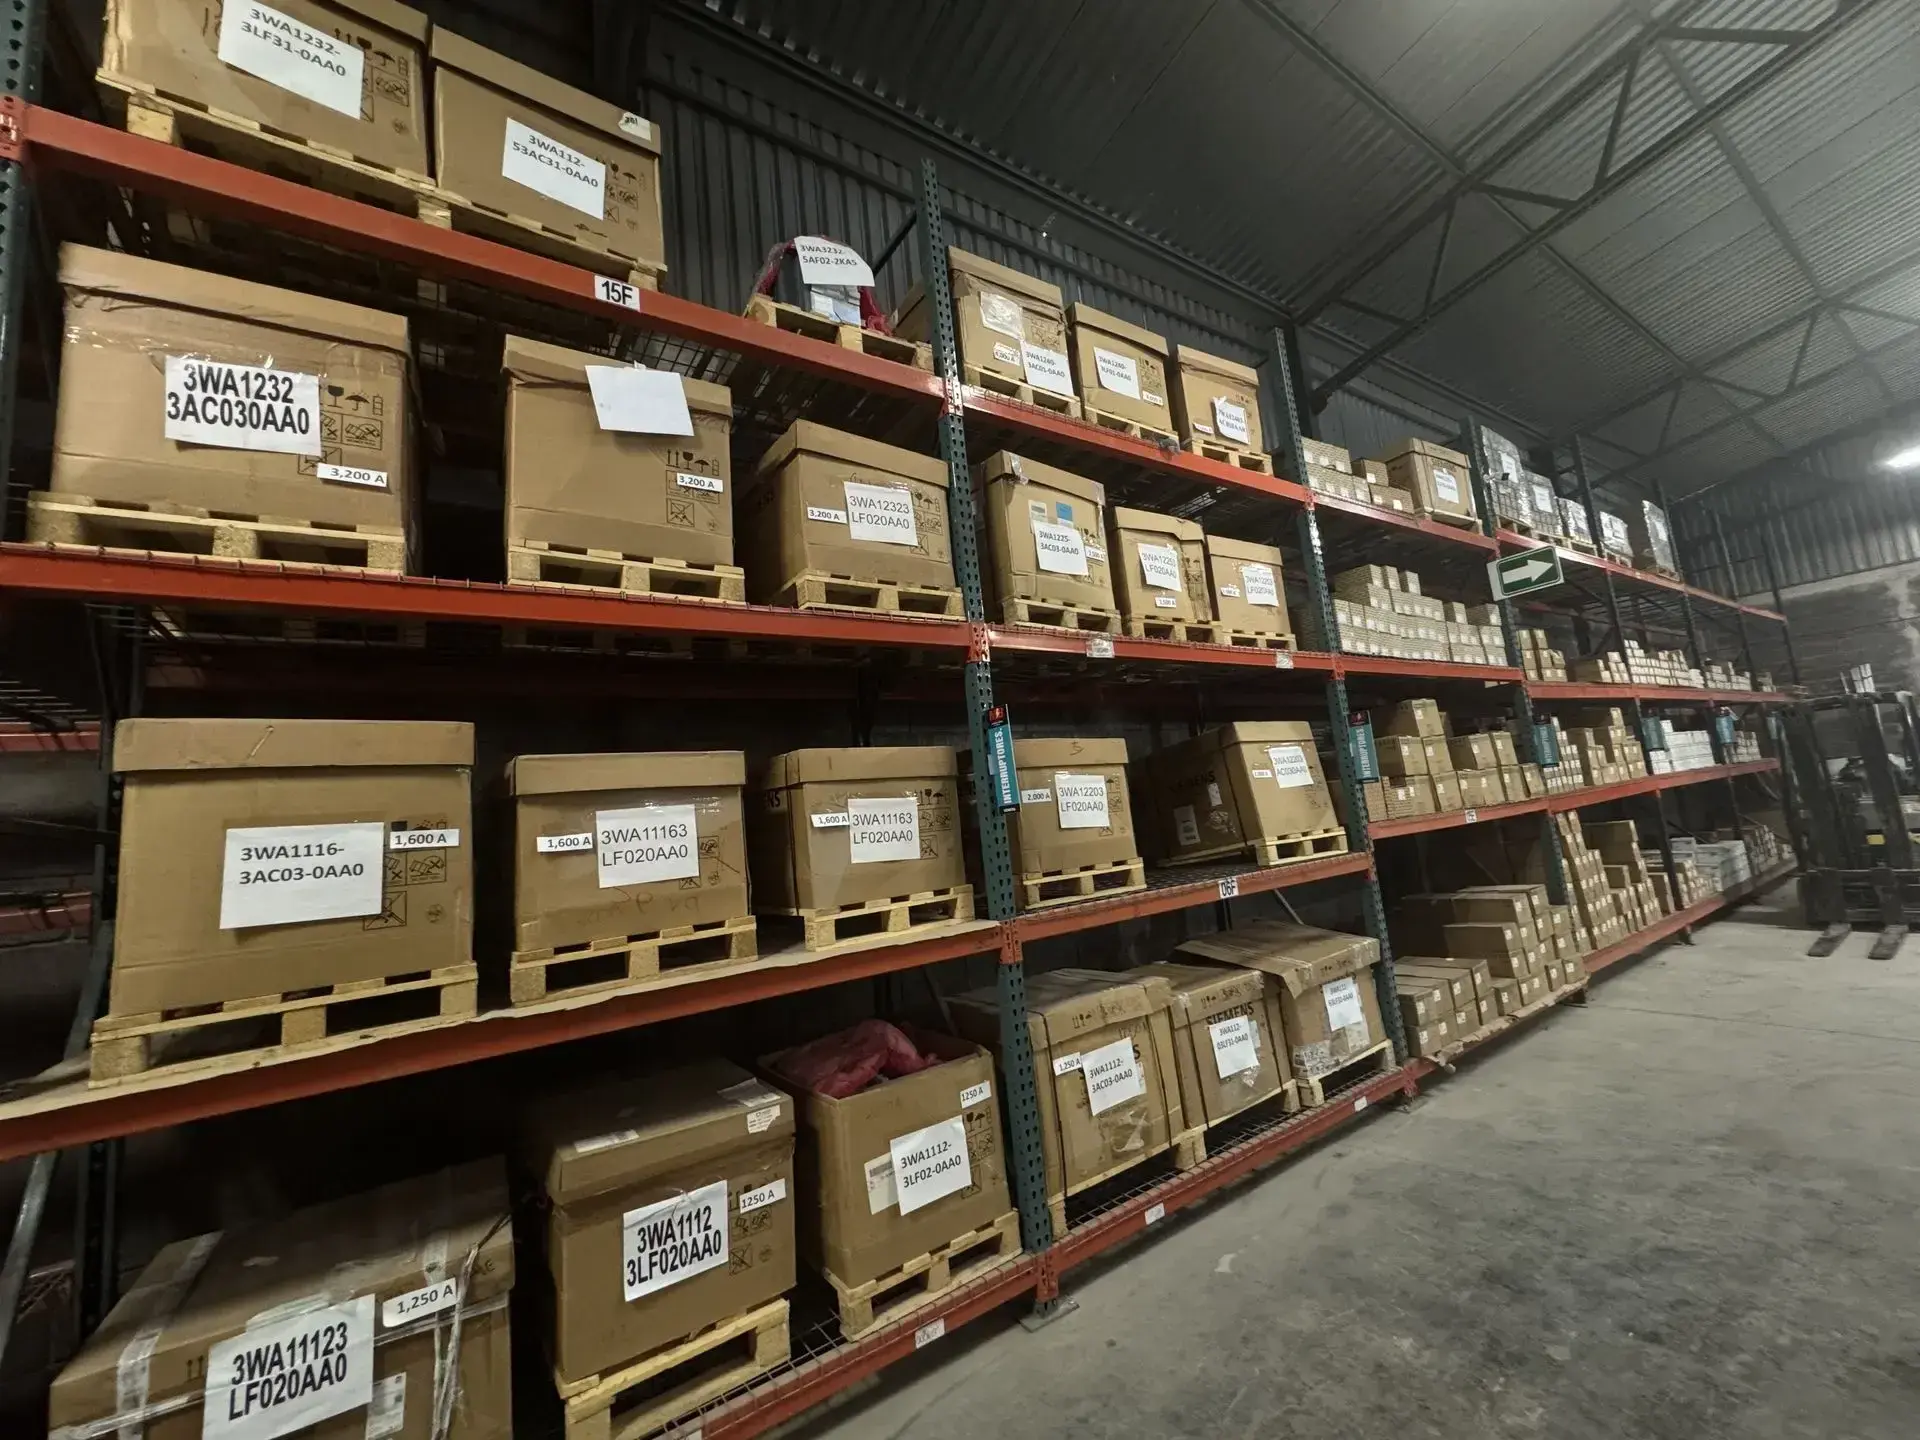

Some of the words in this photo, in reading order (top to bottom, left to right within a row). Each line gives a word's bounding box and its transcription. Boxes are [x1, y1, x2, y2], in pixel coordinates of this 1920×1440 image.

[250, 8, 341, 56] 3WA1232-
[240, 21, 346, 77] 3LF31-0AA0
[528, 134, 585, 167] 3WA112-
[512, 141, 599, 188] 53AC31-0AA0
[601, 280, 632, 304] 15F
[183, 364, 294, 404] 3WA1232
[167, 392, 310, 435] 3AC030AA0
[330, 467, 371, 482] 3,200
[374, 475, 385, 484] A
[679, 476, 705, 487] 3,200
[708, 481, 715, 489] A
[850, 496, 909, 514] 3WA12323
[834, 513, 840, 521] A
[852, 512, 910, 529] LF020AA0
[1059, 786, 1103, 797] 3WA12203
[1061, 801, 1103, 812] LF020AA0
[819, 816, 839, 825] 1,600
[841, 815, 847, 823] A
[852, 812, 913, 826] 3WA11163
[394, 834, 433, 846] 1,600
[437, 833, 447, 843] A
[547, 837, 580, 849] 1,600
[582, 836, 591, 845] A
[601, 824, 688, 845] 3WA11163
[853, 830, 913, 844] LF020AA0
[240, 842, 344, 861] 3WA1116-
[602, 844, 688, 866] LF020AA0
[239, 863, 364, 884] 3AC03-0AA0
[1221, 881, 1237, 896] 06F
[1089, 1058, 1124, 1079] 3WA1112-
[1092, 1069, 1133, 1093] 3AC03-0AA0
[961, 1089, 977, 1101] 1250
[978, 1087, 983, 1095] A
[900, 1141, 951, 1169] 3WA1112-
[903, 1155, 961, 1188] 3LF02-0AA0
[742, 1194, 765, 1209] 1250
[767, 1190, 775, 1199] A
[637, 1205, 712, 1253] 3WA1112
[627, 1229, 721, 1286] 3LF020AA0
[397, 1289, 438, 1315] 1,250
[442, 1284, 454, 1299] A
[231, 1321, 348, 1386] 3WA11123
[228, 1353, 348, 1422] LF020AA0
